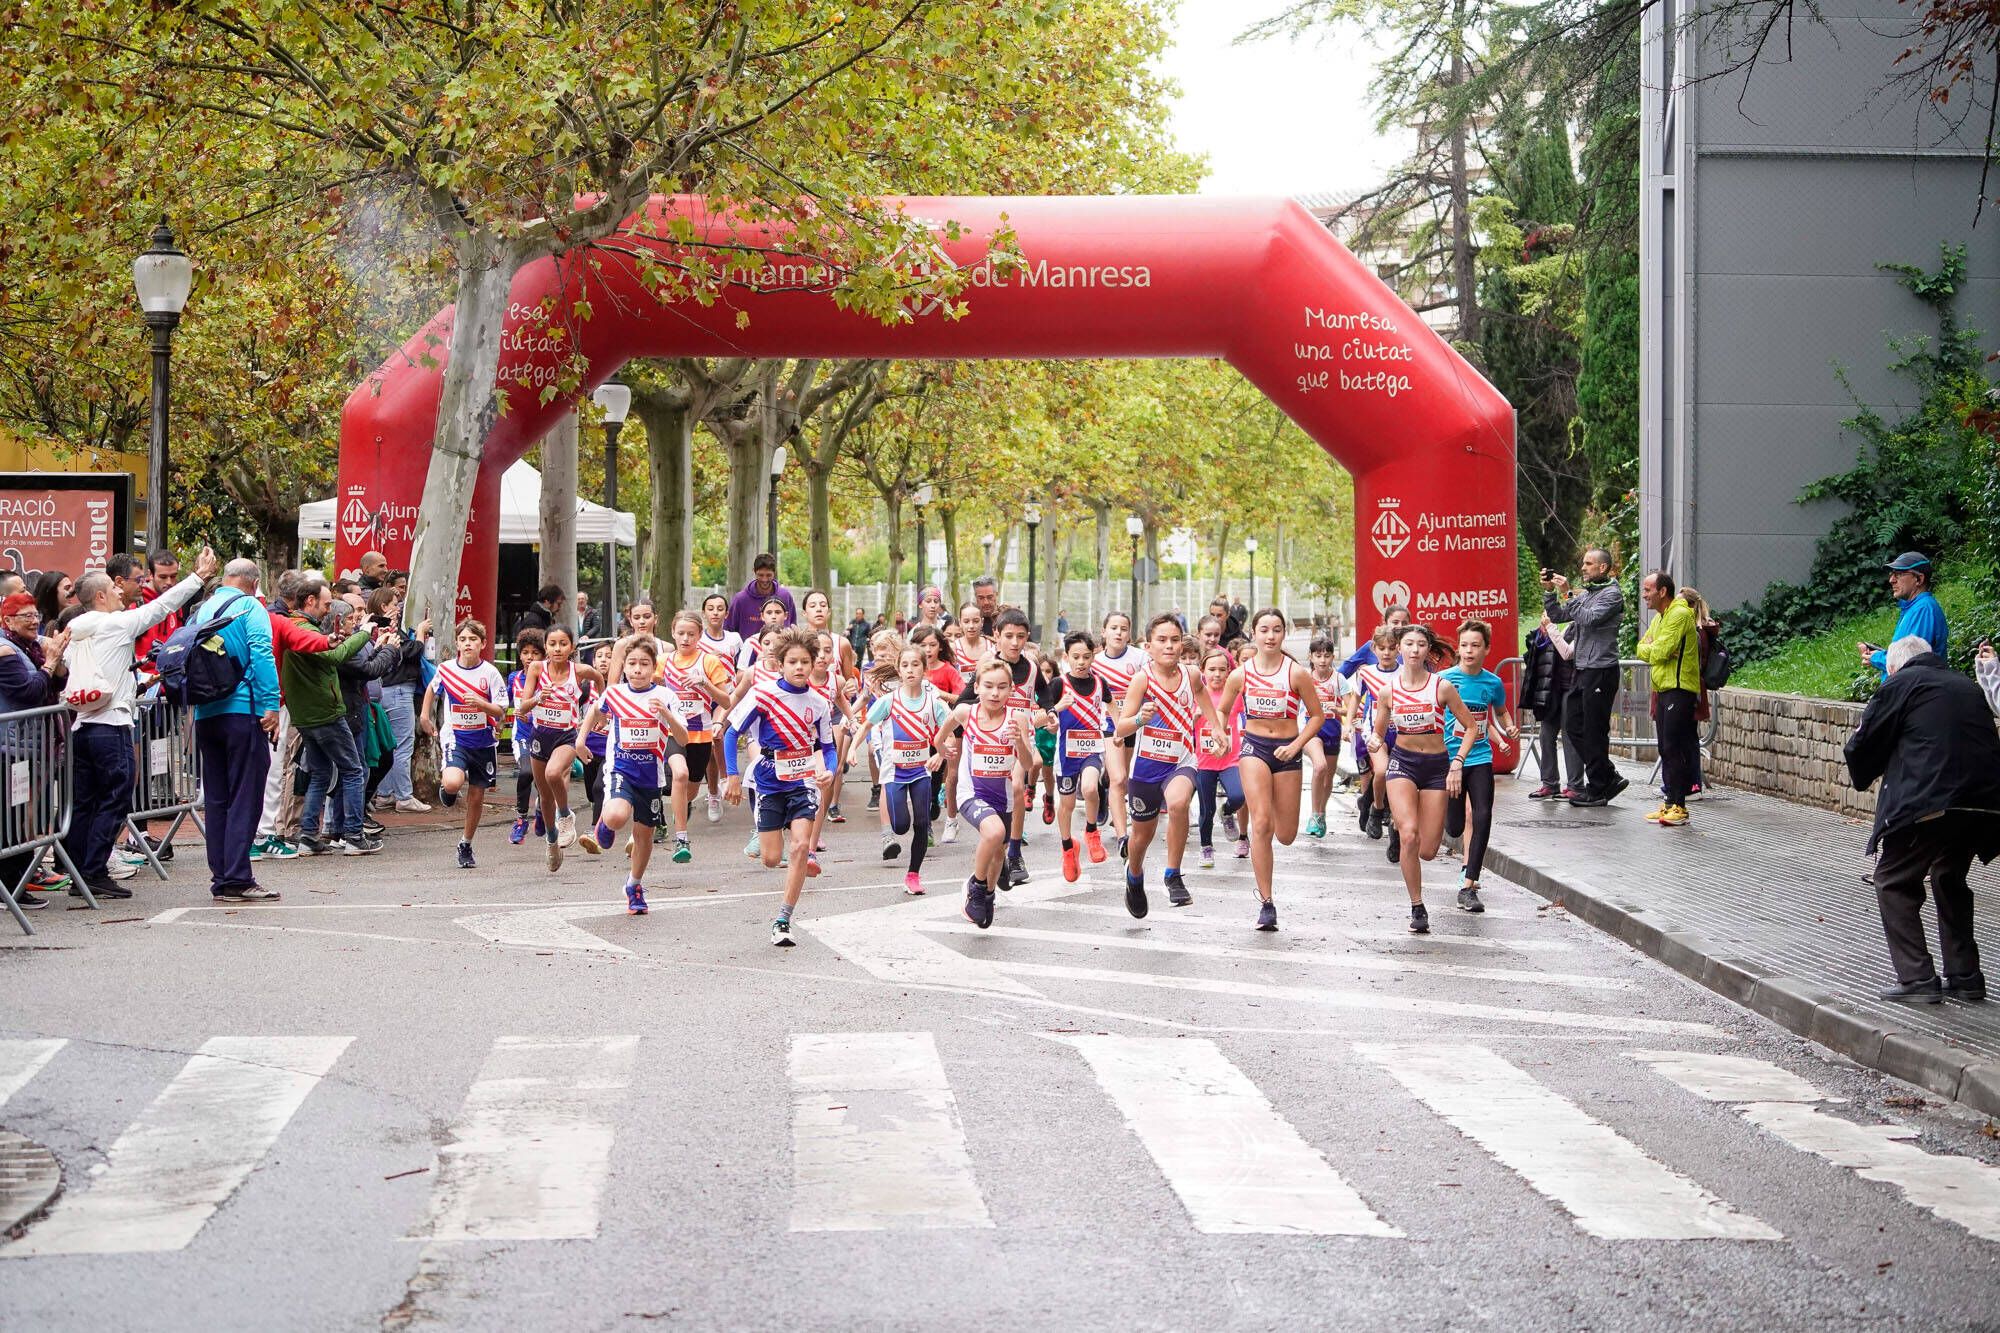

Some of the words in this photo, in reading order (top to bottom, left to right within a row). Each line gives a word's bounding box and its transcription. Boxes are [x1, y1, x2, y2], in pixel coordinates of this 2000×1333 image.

[1021, 259, 1151, 288] Manresa
[1304, 306, 1398, 334] Manresa,
[1294, 342, 1334, 361] una
[1342, 338, 1413, 361] ciutat
[498, 362, 556, 388] atega
[1297, 371, 1329, 394] que
[1340, 369, 1413, 398] batega
[1417, 511, 1507, 534] Ajuntament
[84, 498, 109, 575] Benet
[1417, 535, 1440, 552] de
[1445, 535, 1507, 551] Manresa
[1416, 588, 1508, 609] MANRESA
[1416, 610, 1439, 621] Cor
[1441, 609, 1457, 620] de
[1459, 607, 1509, 620] Catalunya
[1256, 697, 1277, 707] 1006
[460, 713, 478, 721] 1025
[545, 709, 562, 718] 1015
[1403, 713, 1425, 722] 1004
[630, 728, 649, 737] 1031
[1076, 739, 1096, 747] 1008
[1152, 738, 1172, 749] 1014
[902, 750, 921, 758] 1026
[983, 755, 1005, 765] 1032
[787, 758, 807, 768] 1022
